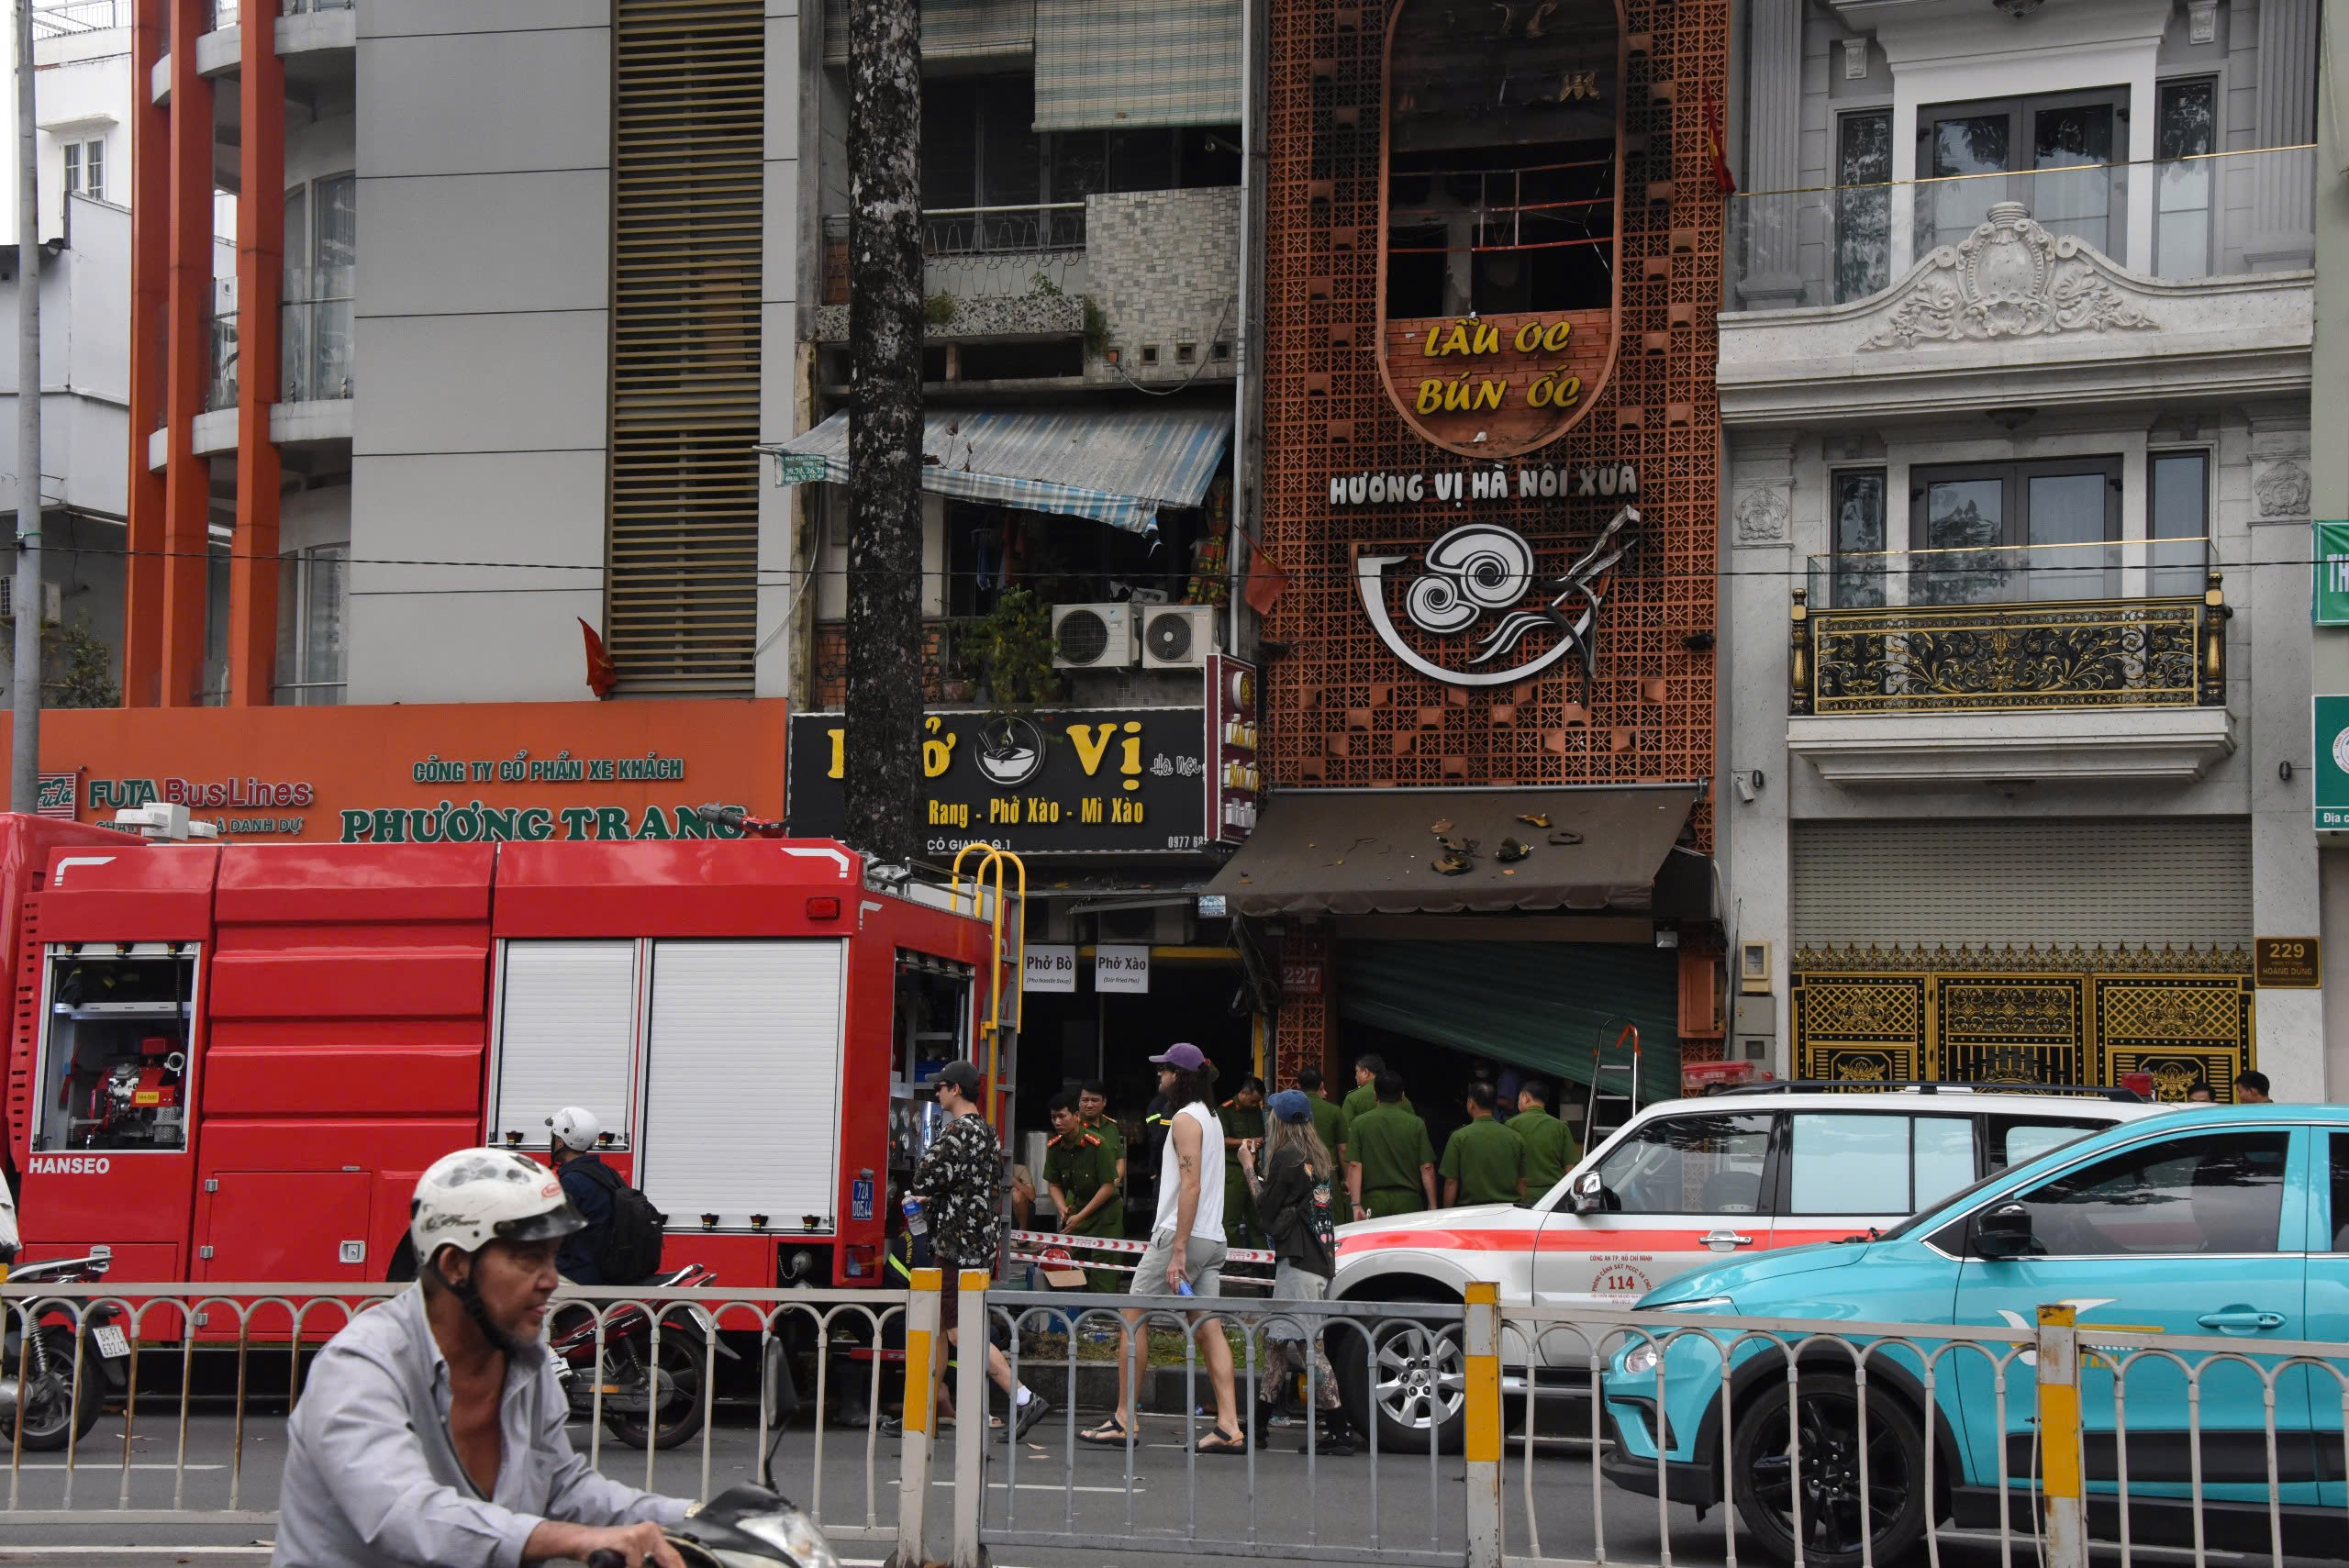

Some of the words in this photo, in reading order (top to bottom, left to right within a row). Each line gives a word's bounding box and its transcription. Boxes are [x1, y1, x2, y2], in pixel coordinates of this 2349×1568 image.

[1416, 371, 1508, 415] BÚN
[1526, 364, 1581, 407] ỐC
[1330, 471, 1424, 504] HƯƠNG
[1434, 472, 1463, 507] VỊ
[1472, 463, 1508, 499] HÀ
[1578, 462, 1637, 496] XƯA
[1065, 721, 1142, 791] Vị
[1150, 752, 1174, 776] Hà
[1176, 755, 1202, 777] Nội
[413, 754, 465, 782] CÔNG
[472, 761, 494, 782] TY
[499, 749, 528, 782] CỔ
[587, 760, 615, 780] XE
[618, 752, 685, 779] KHÁCH
[89, 779, 159, 808] FUTA
[929, 799, 969, 828] Rang
[989, 795, 1020, 824] Phở
[1028, 796, 1059, 823] Xào
[1081, 796, 1103, 823] Mì
[1111, 796, 1143, 823] Xào
[2322, 812, 2341, 826] Địa
[229, 818, 275, 833] DANH
[278, 816, 304, 835] DỰ
[340, 800, 556, 843] PHƯƠNG
[560, 805, 749, 840] TRANG
[927, 836, 946, 851] CÔ
[991, 839, 1010, 851] Q.1
[1168, 836, 1190, 849] 0977
[2269, 943, 2305, 958] 229
[1026, 955, 1053, 970] Phở
[1056, 955, 1073, 970] Bò
[1098, 956, 1122, 970] Phở
[1124, 956, 1146, 971] Xào
[1283, 967, 1319, 984] 227
[28, 1157, 110, 1174] HANSEO
[857, 1182, 870, 1200] 72A
[1608, 1275, 1635, 1290] 114
